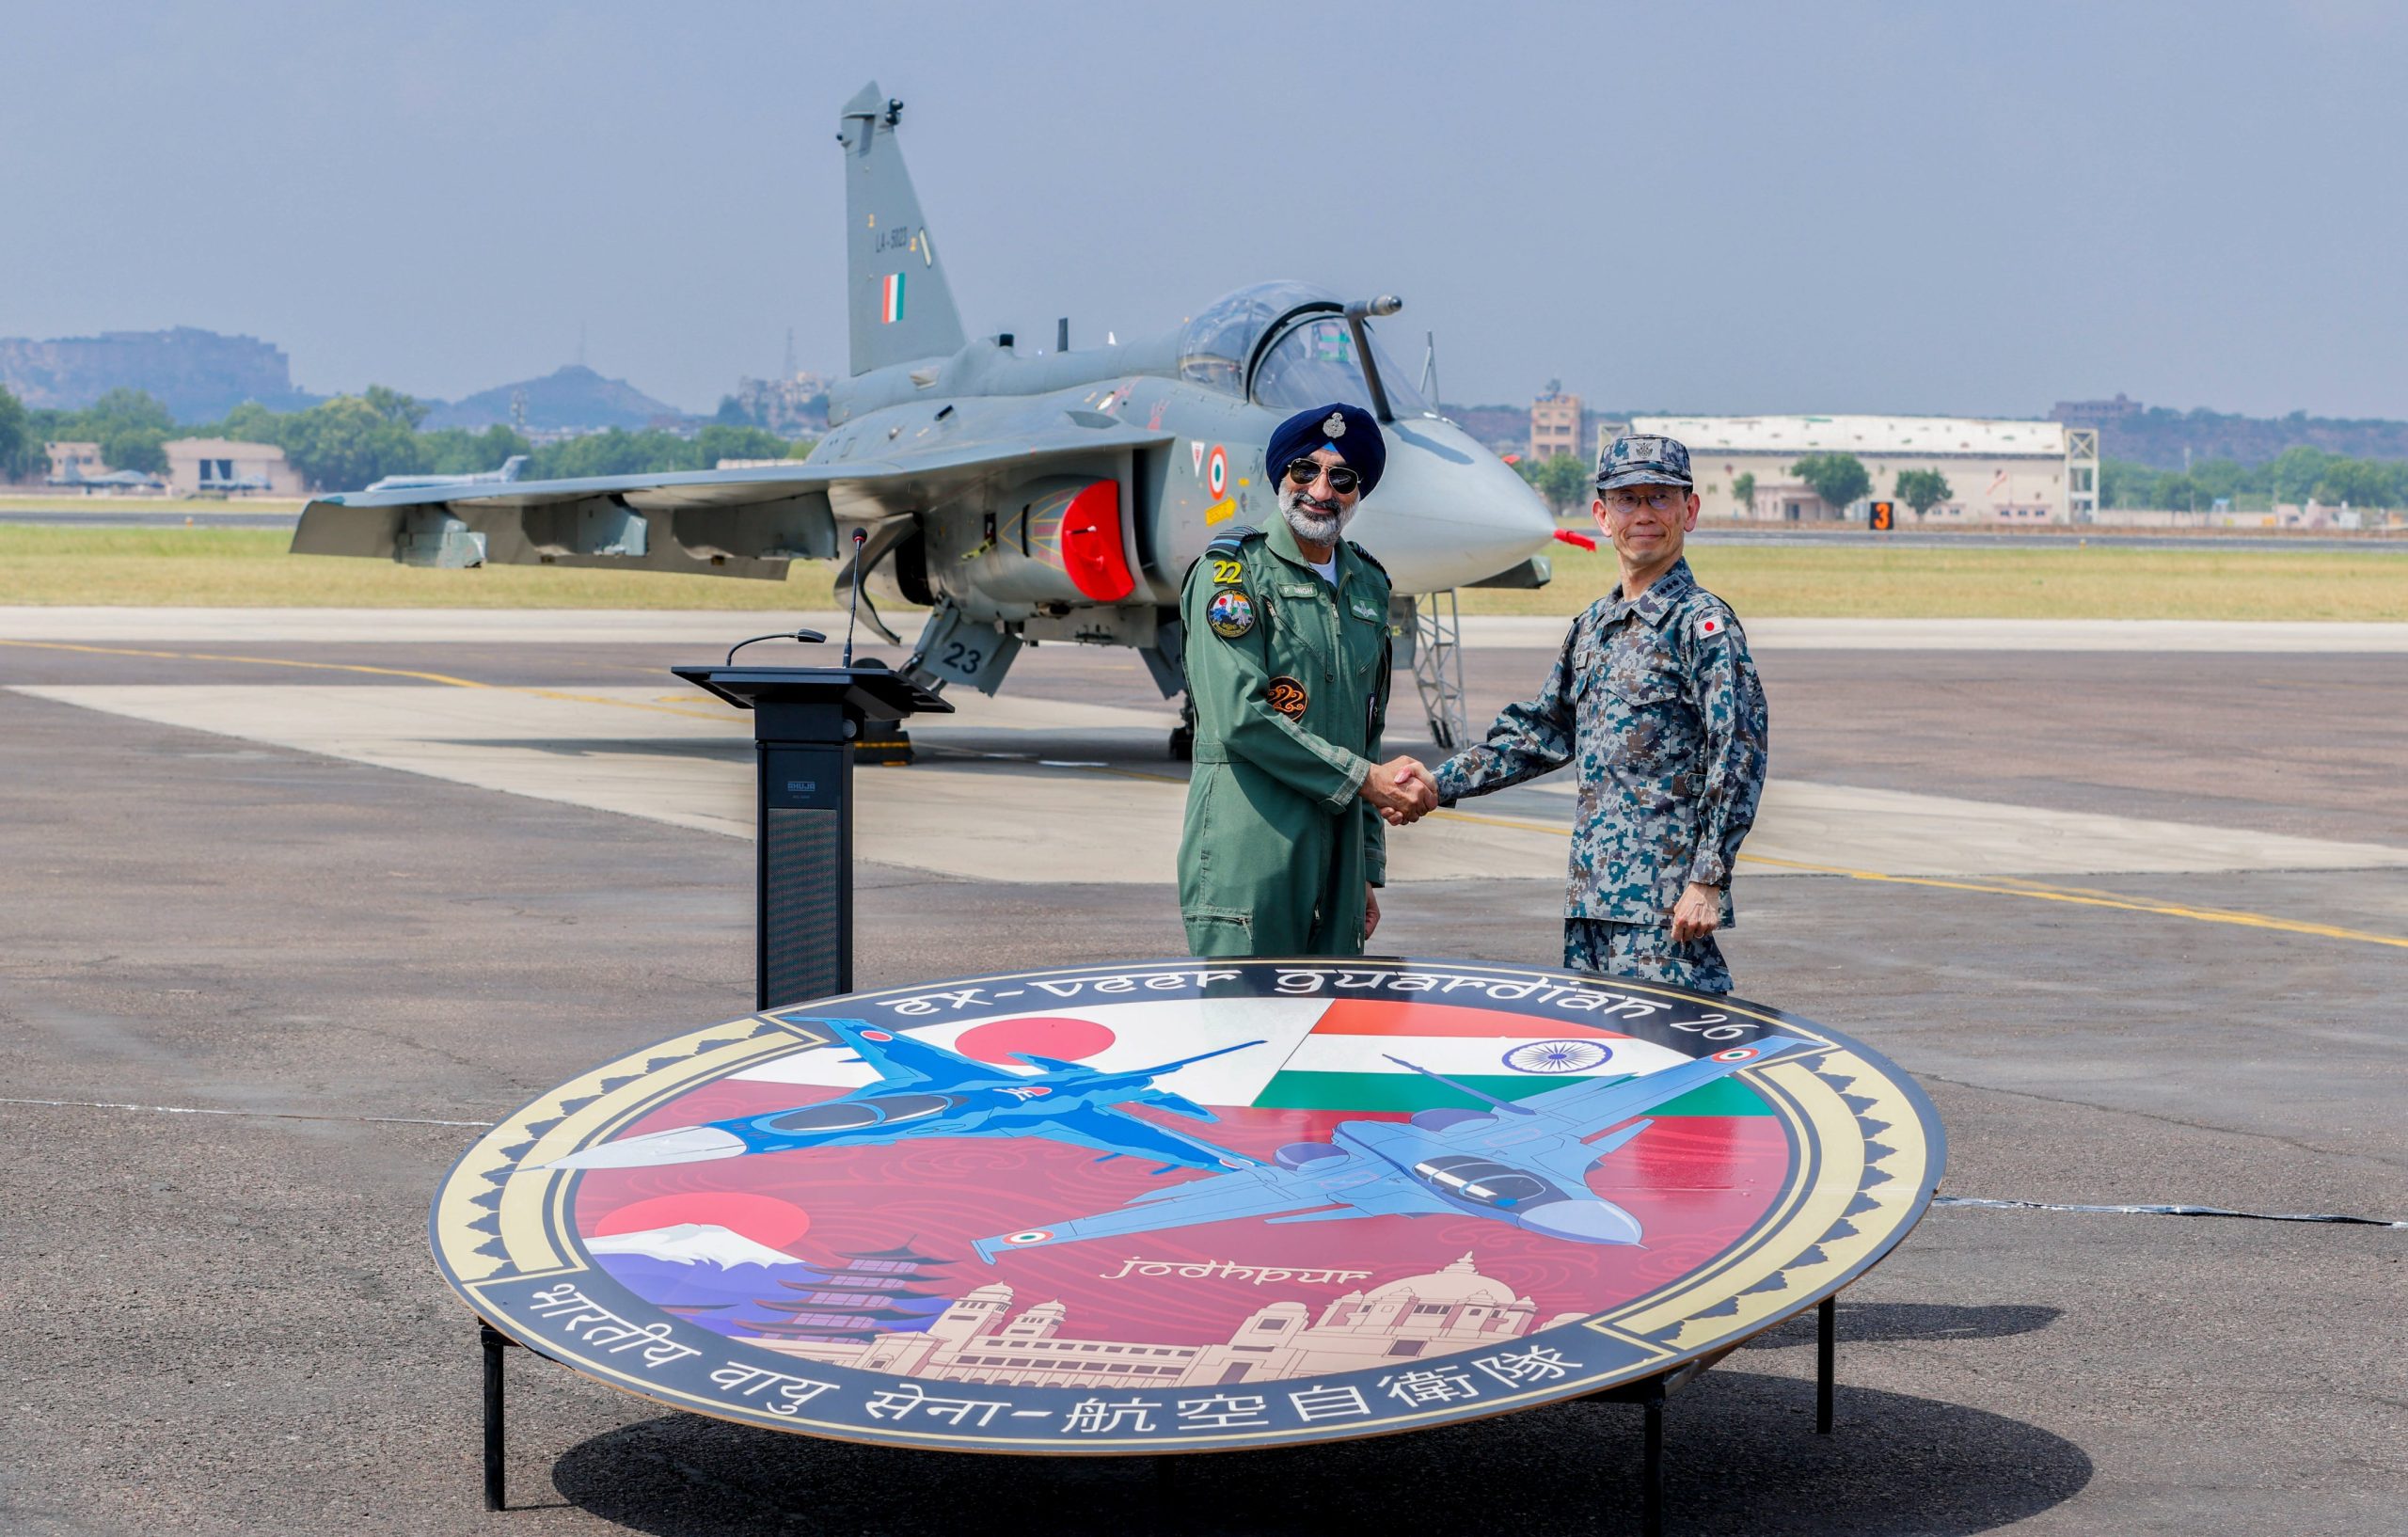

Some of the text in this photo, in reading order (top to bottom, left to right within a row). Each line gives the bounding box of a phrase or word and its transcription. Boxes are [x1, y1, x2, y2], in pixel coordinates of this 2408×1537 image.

[1874, 502, 1890, 531] 3
[1213, 560, 1243, 584] 22
[942, 642, 981, 674] 23
[1670, 1014, 1761, 1040] 26
[1100, 1256, 1373, 1286] jodhpur
[530, 1283, 703, 1369] भारतीय
[709, 1361, 841, 1416] वायु
